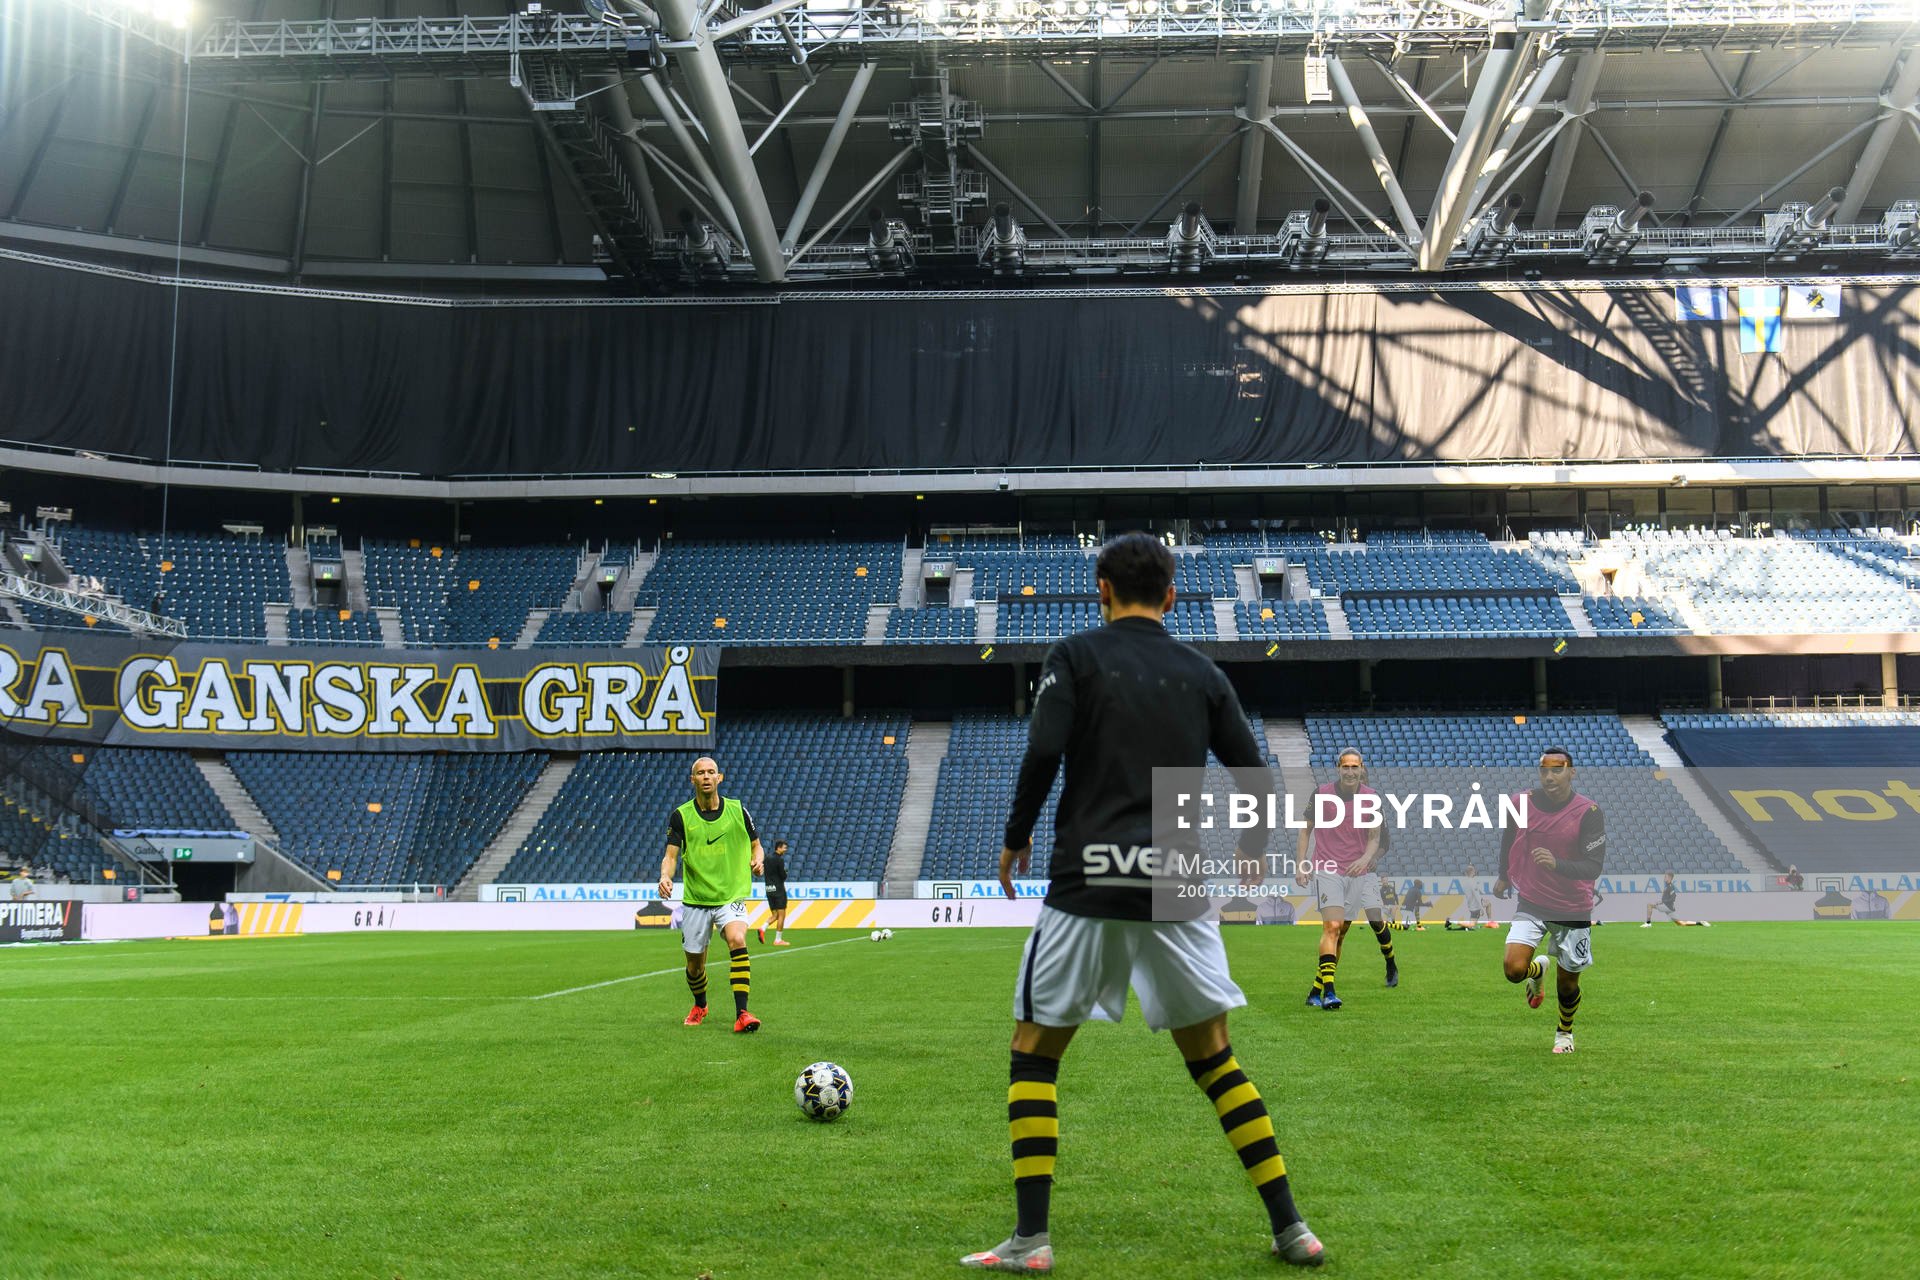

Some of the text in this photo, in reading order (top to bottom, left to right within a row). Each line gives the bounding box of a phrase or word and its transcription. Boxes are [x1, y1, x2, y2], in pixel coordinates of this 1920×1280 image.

[118, 655, 497, 736] GANSKA
[523, 645, 707, 735] GRÅ
[1082, 843, 1188, 877] SVEA
